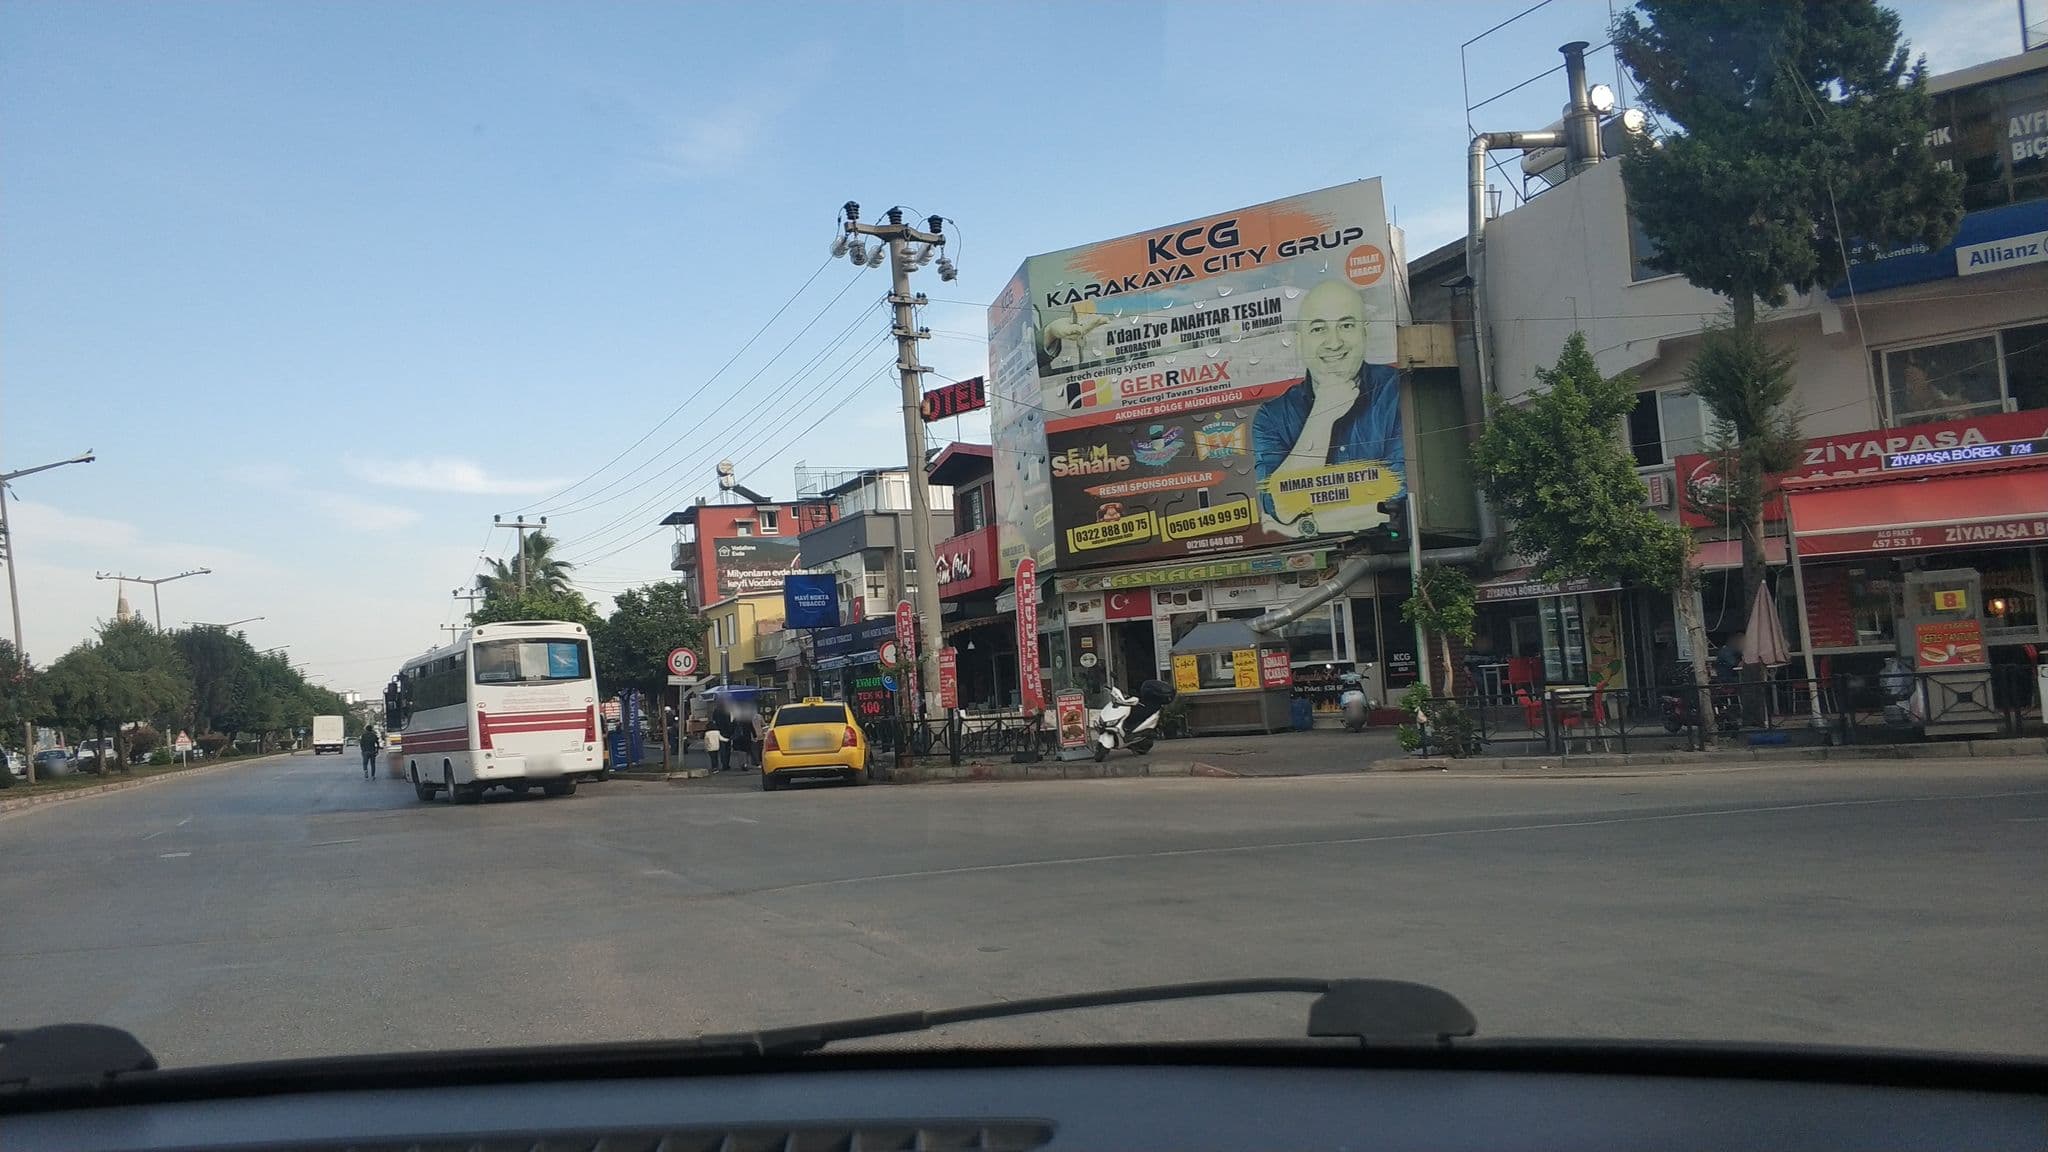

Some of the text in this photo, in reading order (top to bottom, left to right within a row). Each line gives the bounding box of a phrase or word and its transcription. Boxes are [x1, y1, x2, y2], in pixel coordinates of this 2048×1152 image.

[1148, 219, 1240, 265] KCG
[1969, 243, 2038, 267] Allianz
[1047, 227, 1364, 308] KARAKAYA CITY GRUP
[1107, 297, 1281, 346] A'dan Z'ye ANAHTAR TESLİM
[1115, 339, 1161, 355] DEKORASYON
[1066, 360, 1155, 383] strech ceiling system
[1120, 360, 1231, 394] GERRMAX
[922, 380, 985, 421] OTEL
[1166, 388, 1194, 400] Tavan
[1195, 381, 1232, 395] Sistemi
[1952, 444, 2002, 460] BÖREK
[1130, 472, 1212, 492] SPONSORLUKLAR
[1279, 467, 1379, 492] MİMAR SELİM BEY'İN
[1310, 487, 1350, 504] TERCİHİ
[1076, 527, 1100, 543] 0322
[1101, 523, 1120, 538] 888
[1121, 521, 1134, 534] 00
[1135, 518, 1148, 531] 75
[1169, 507, 1248, 534] 0506 149 99 99
[1945, 521, 2048, 542] ZİYAPAŞA B
[1872, 536, 1922, 548] 457 53 17
[772, 568, 791, 577] evde
[1110, 561, 1248, 588] ASMAALTI
[794, 593, 809, 601] MAVİ
[674, 655, 692, 668] 60
[1393, 652, 1411, 661] KCG
